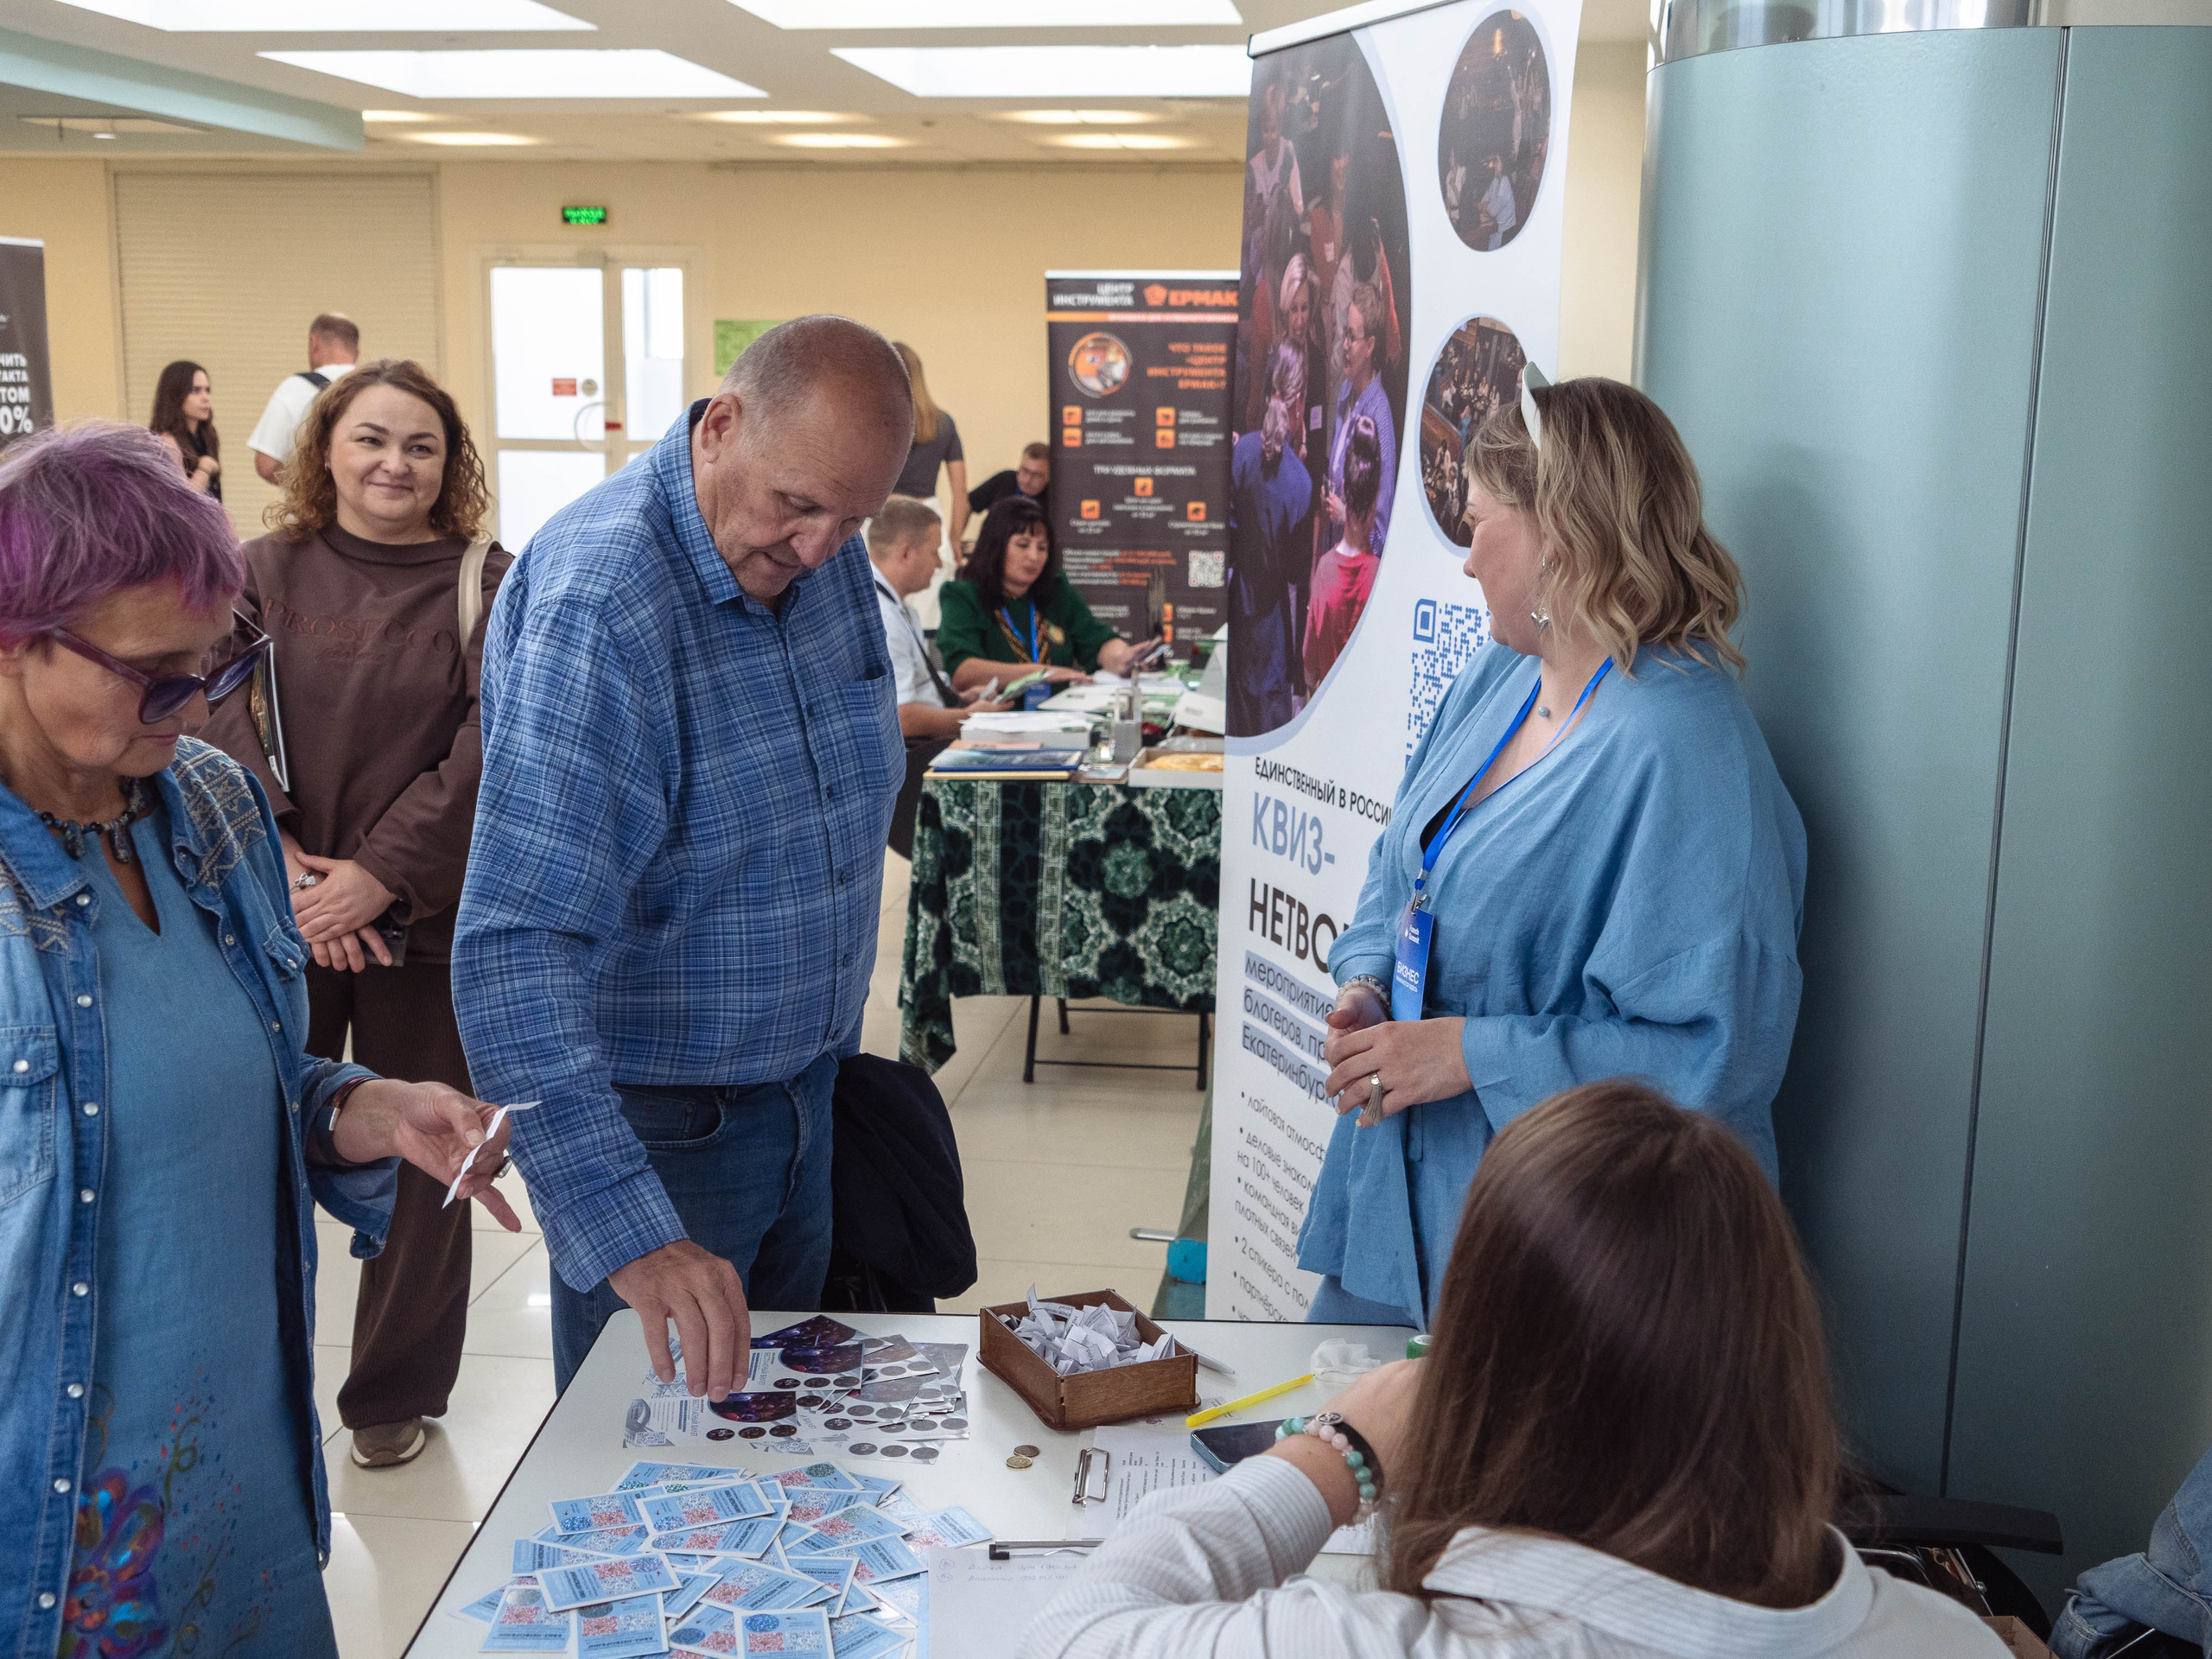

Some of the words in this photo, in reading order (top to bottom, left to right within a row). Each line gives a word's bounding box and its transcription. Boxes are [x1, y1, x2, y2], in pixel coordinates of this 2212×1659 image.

[1168, 289, 1238, 307] ЕРМАК
[0, 369, 29, 382] АКТА
[1255, 756, 1335, 805] ЕДИНСТВЕННЫЙ
[1339, 788, 1346, 808] В
[1253, 791, 1335, 875] КВИЗ-
[1249, 877, 1349, 973] НЕТВО
[1396, 961, 1419, 985] БИЗНЕС
[1244, 988, 1304, 1050] блогеров,
[1243, 1025, 1341, 1108] Екатеринбур
[1248, 1096, 1285, 1133] лайтовая
[1286, 1125, 1325, 1165] атмосф
[1237, 1150, 1249, 1168] на
[1252, 1157, 1270, 1181] 100+
[1272, 1175, 1304, 1215] человек
[1246, 1132, 1281, 1167] деловые
[1282, 1160, 1315, 1192] знаком
[1235, 1199, 1269, 1237] плотных
[1244, 1180, 1289, 1230] командная
[1291, 1221, 1300, 1236] ви
[1241, 1236, 1248, 1255] 2
[1249, 1247, 1283, 1287] спикера
[1284, 1281, 1290, 1295] с
[1292, 1287, 1309, 1310] пол
